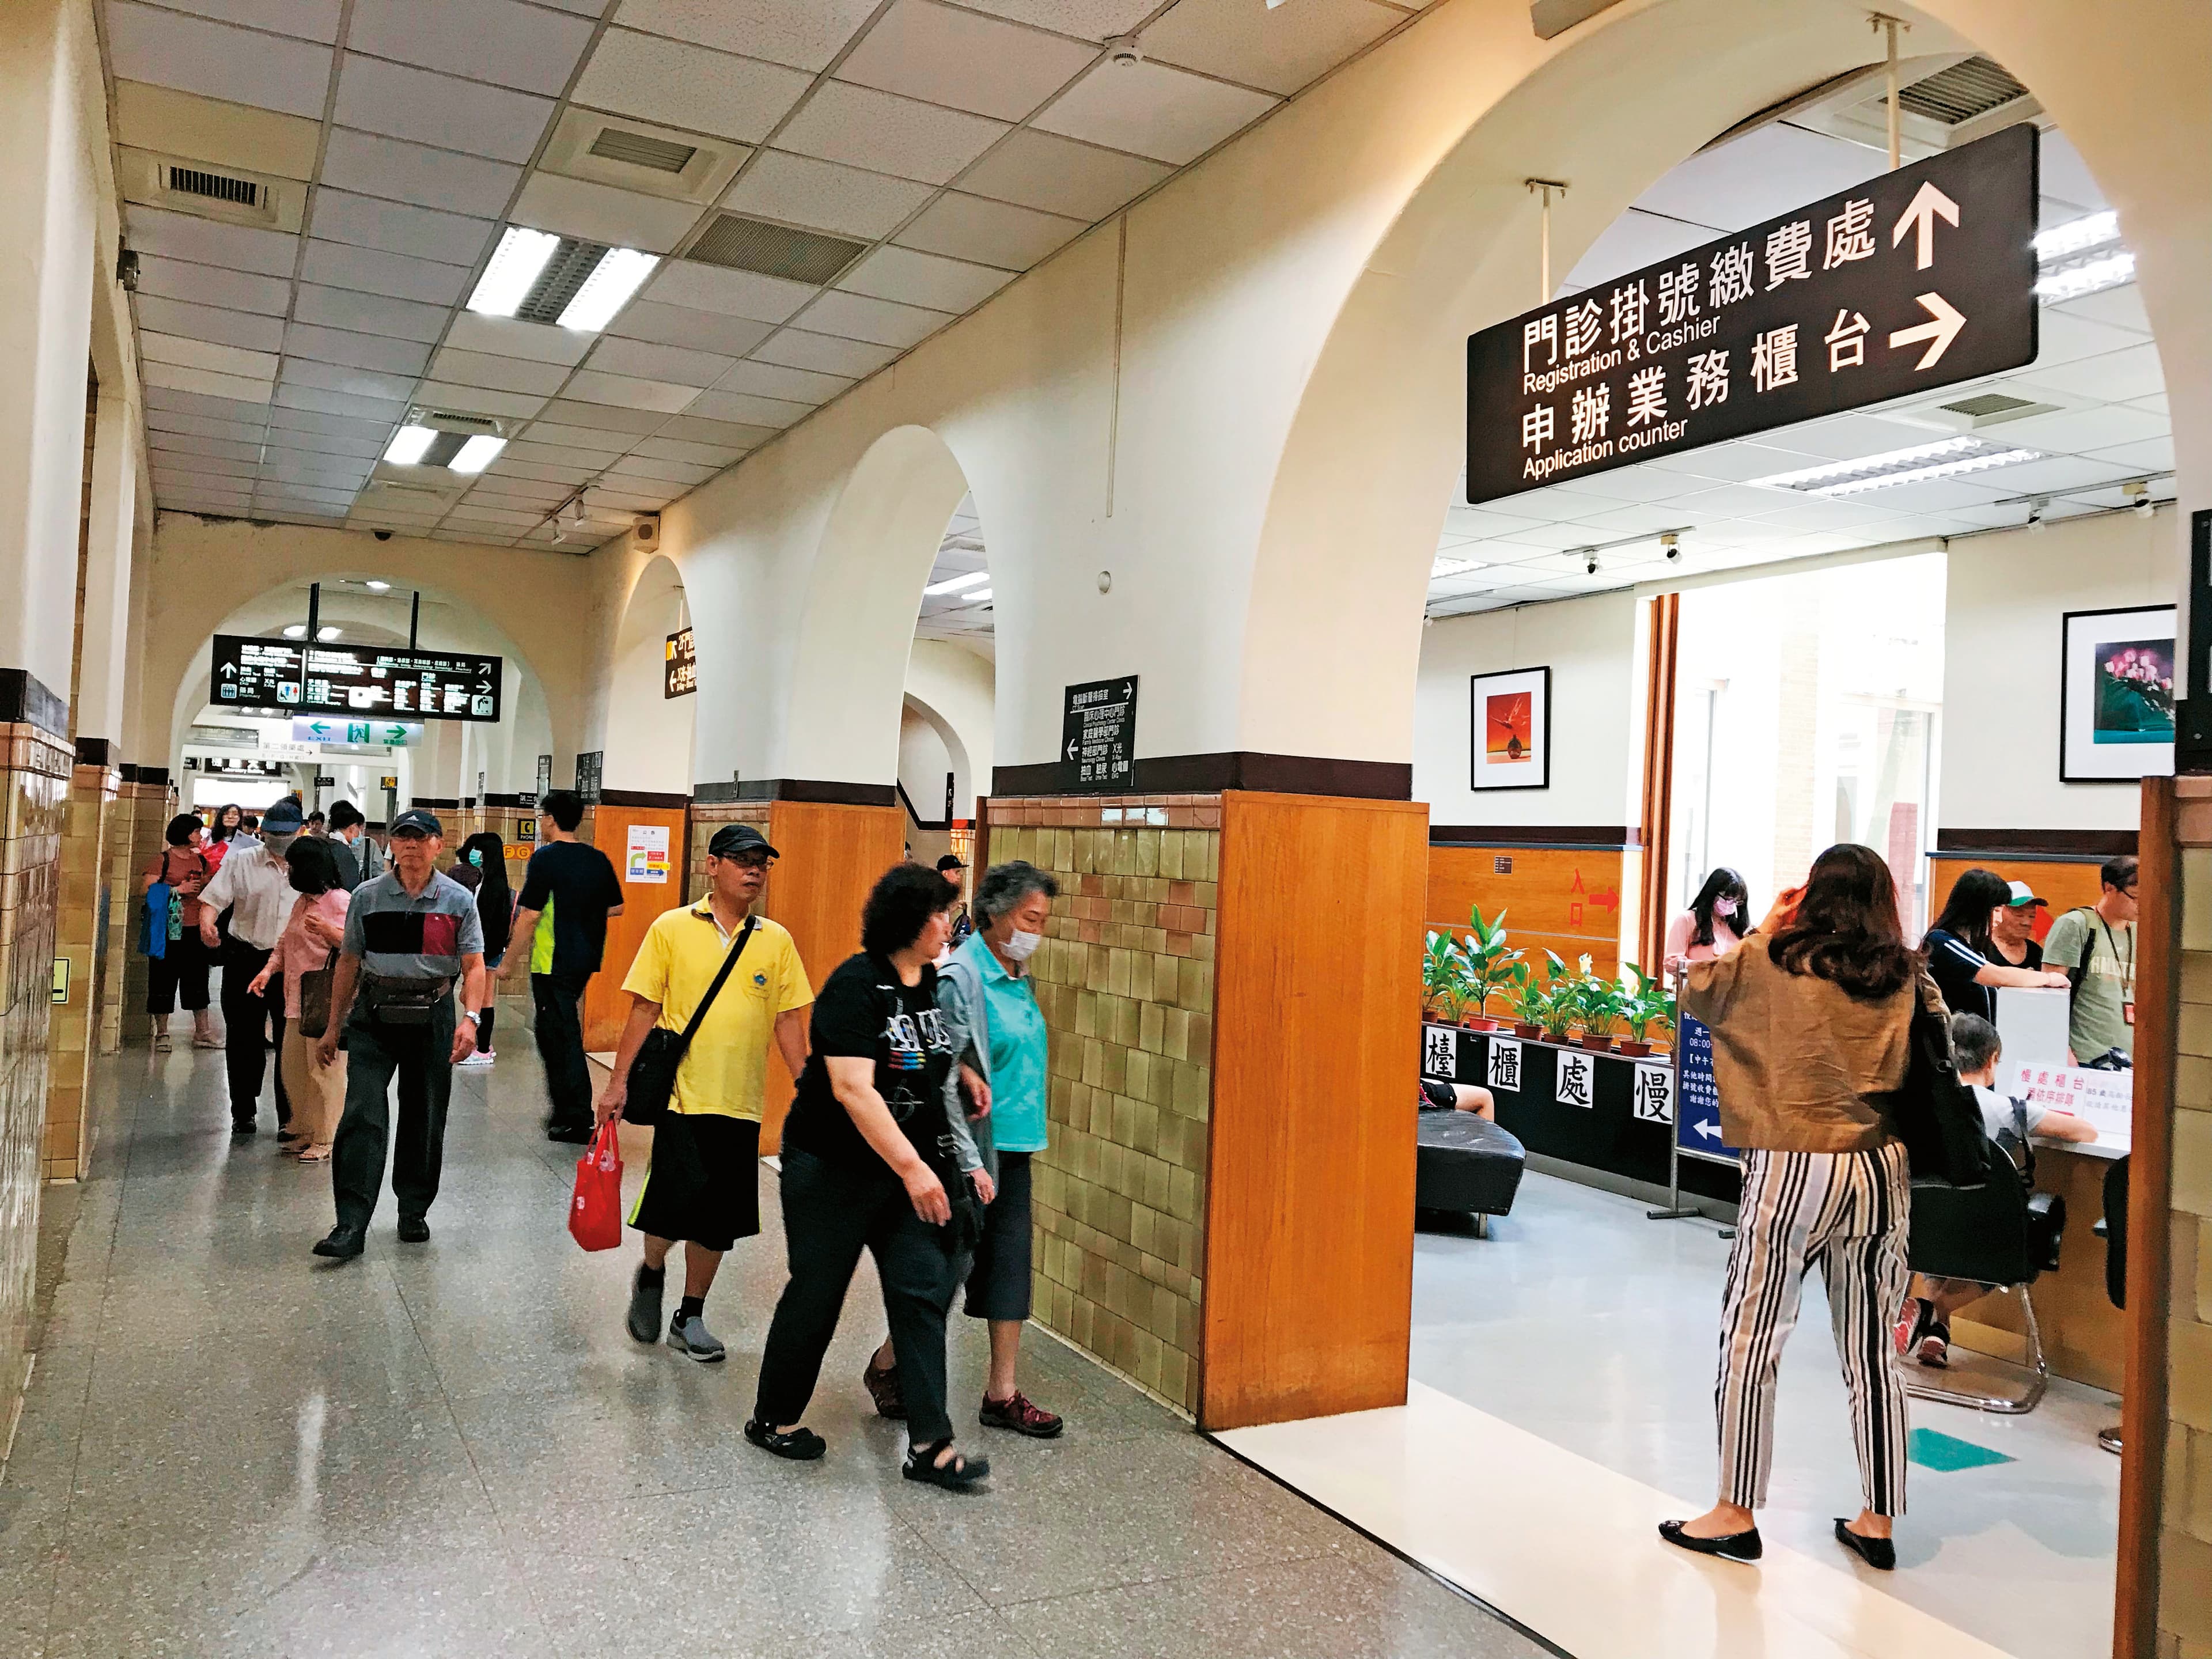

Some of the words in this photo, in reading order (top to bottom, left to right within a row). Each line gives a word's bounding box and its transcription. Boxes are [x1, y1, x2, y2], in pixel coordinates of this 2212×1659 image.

[1522, 199, 1876, 373] 門診掛號繳費處
[1522, 309, 1871, 455] 申辦業務櫃台
[1523, 346, 1622, 395] Registration
[1628, 340, 1641, 361] &
[1646, 315, 1721, 355] Cashier
[1523, 441, 1613, 480] Application
[1619, 419, 1688, 454] counter
[1570, 868, 1586, 926] 入口
[1488, 1043, 1520, 1089] 櫃
[1559, 1056, 1589, 1105] 處
[1683, 1069, 1715, 1083] 其他時間
[1636, 1070, 1672, 1121] 慢
[1689, 1094, 1719, 1108] 謝謝您的
